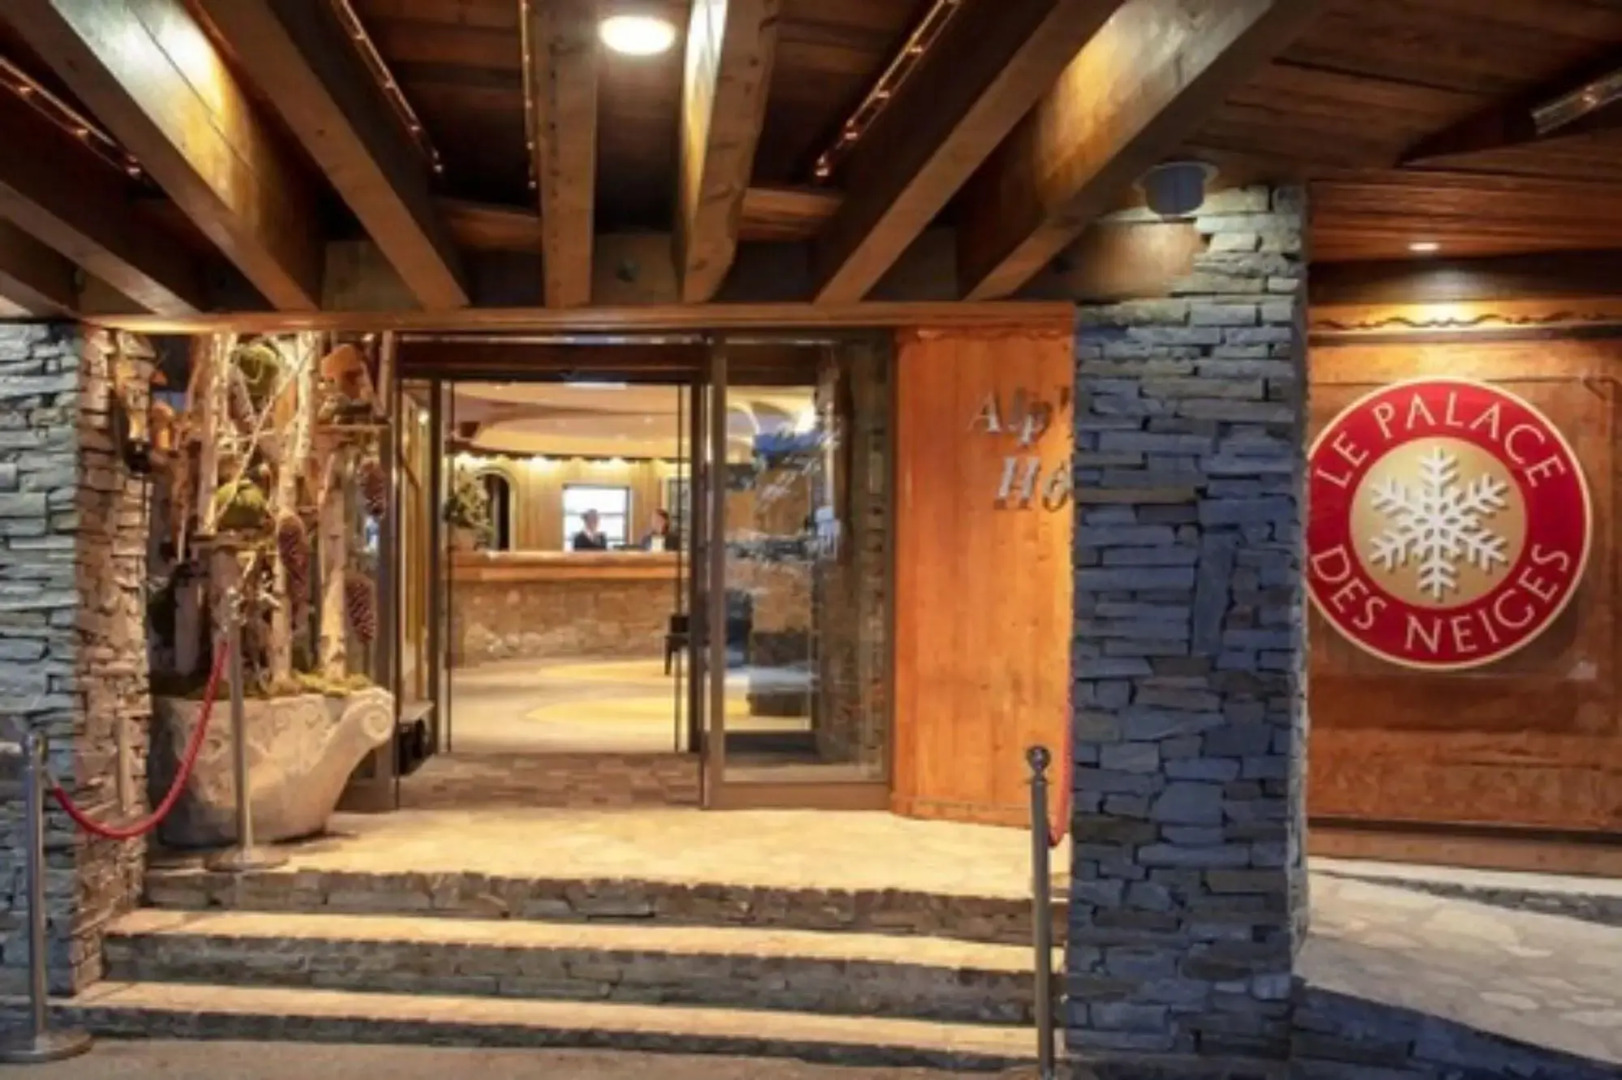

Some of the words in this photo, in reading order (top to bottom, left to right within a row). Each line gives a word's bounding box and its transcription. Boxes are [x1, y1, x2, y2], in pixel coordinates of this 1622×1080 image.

[1315, 432, 1370, 489] LE
[1372, 390, 1567, 488] PALACE
[1310, 544, 1387, 631] DES
[1404, 544, 1571, 654] NEIGES
